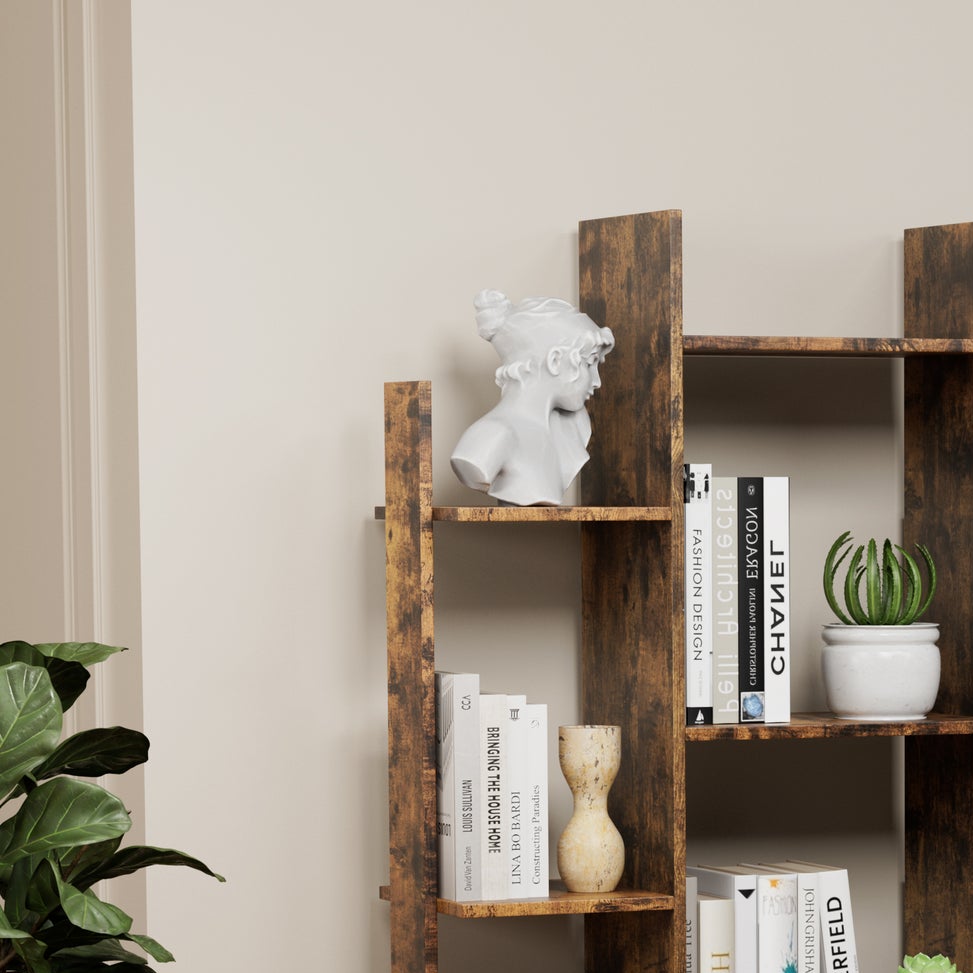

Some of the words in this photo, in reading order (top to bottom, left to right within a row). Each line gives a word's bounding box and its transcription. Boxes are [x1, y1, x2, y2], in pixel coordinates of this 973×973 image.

[692, 529, 703, 597] FASHION
[693, 604, 703, 661] DESIGN
[487, 727, 500, 771] BRINGING
[463, 779, 473, 812] SULLIVAN
[488, 774, 501, 792] THE
[488, 795, 501, 825] HOUSE
[511, 792, 521, 830] BARDI
[531, 785, 541, 823] Paradies
[463, 813, 472, 833] LOUIS
[488, 828, 501, 853] HOME
[511, 834, 521, 851] BO
[532, 826, 543, 885] Constructing
[511, 855, 521, 885] LINA
